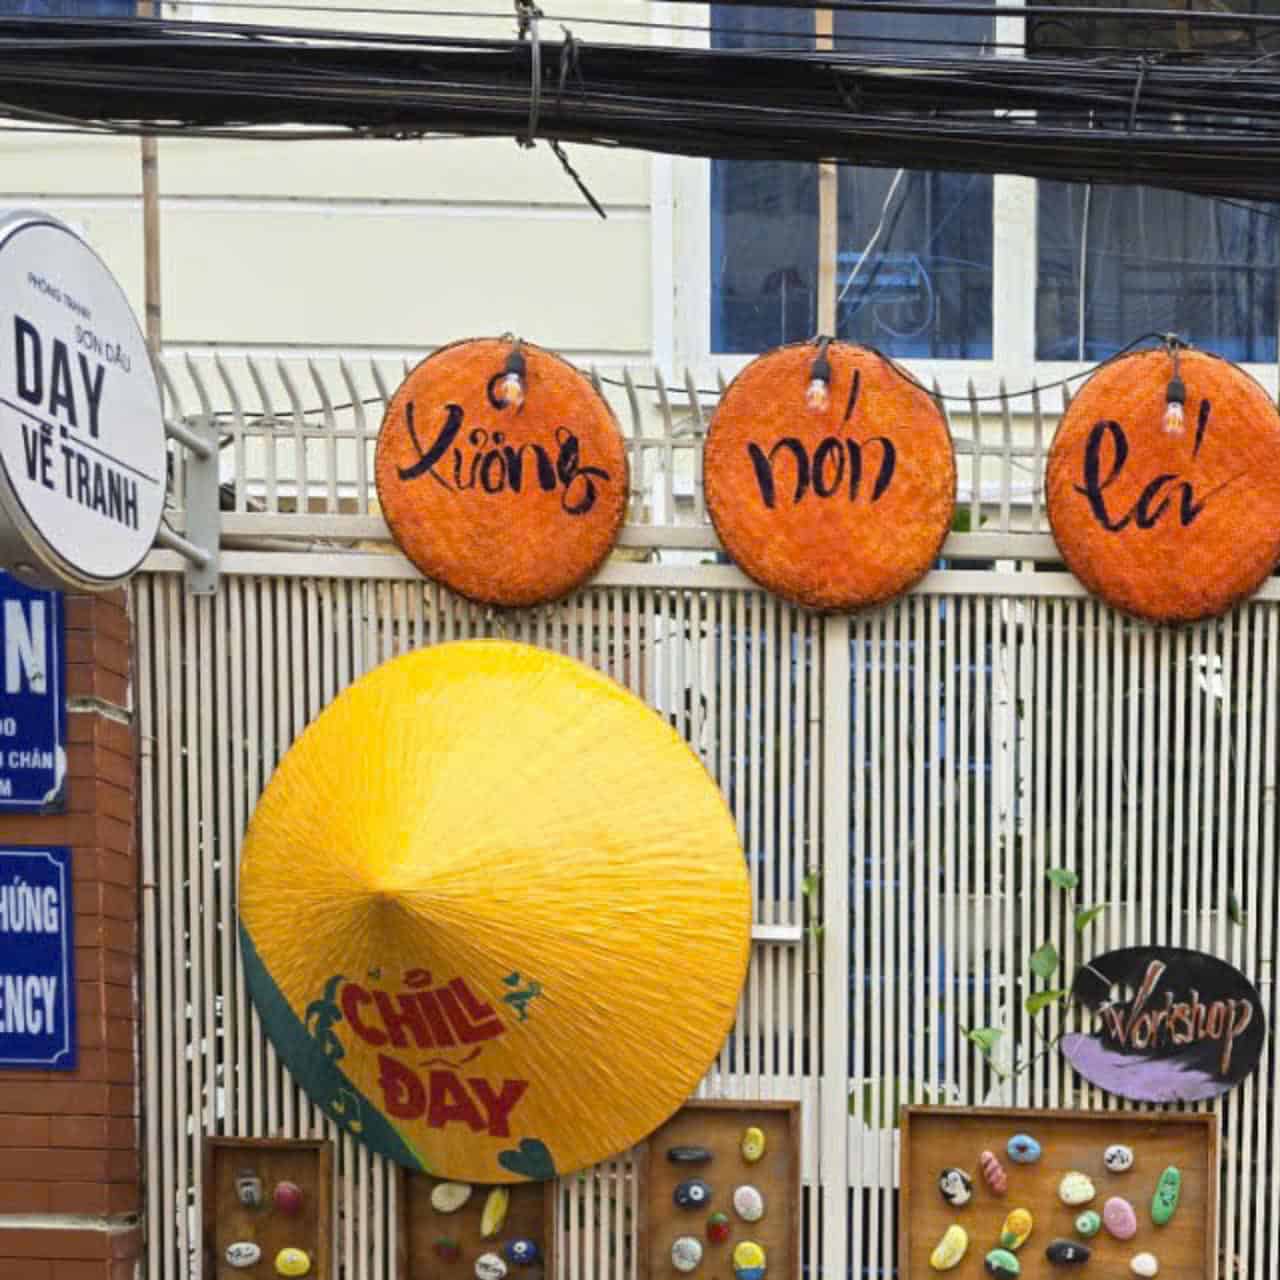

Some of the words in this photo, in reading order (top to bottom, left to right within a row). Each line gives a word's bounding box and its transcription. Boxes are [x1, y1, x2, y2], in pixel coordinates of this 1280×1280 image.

[14, 315, 104, 439] DẠY
[21, 422, 54, 490] VẼ
[61, 445, 139, 531] TRANH
[746, 369, 895, 508] nón
[1073, 400, 1247, 532] lá
[341, 968, 505, 1048] CHILL
